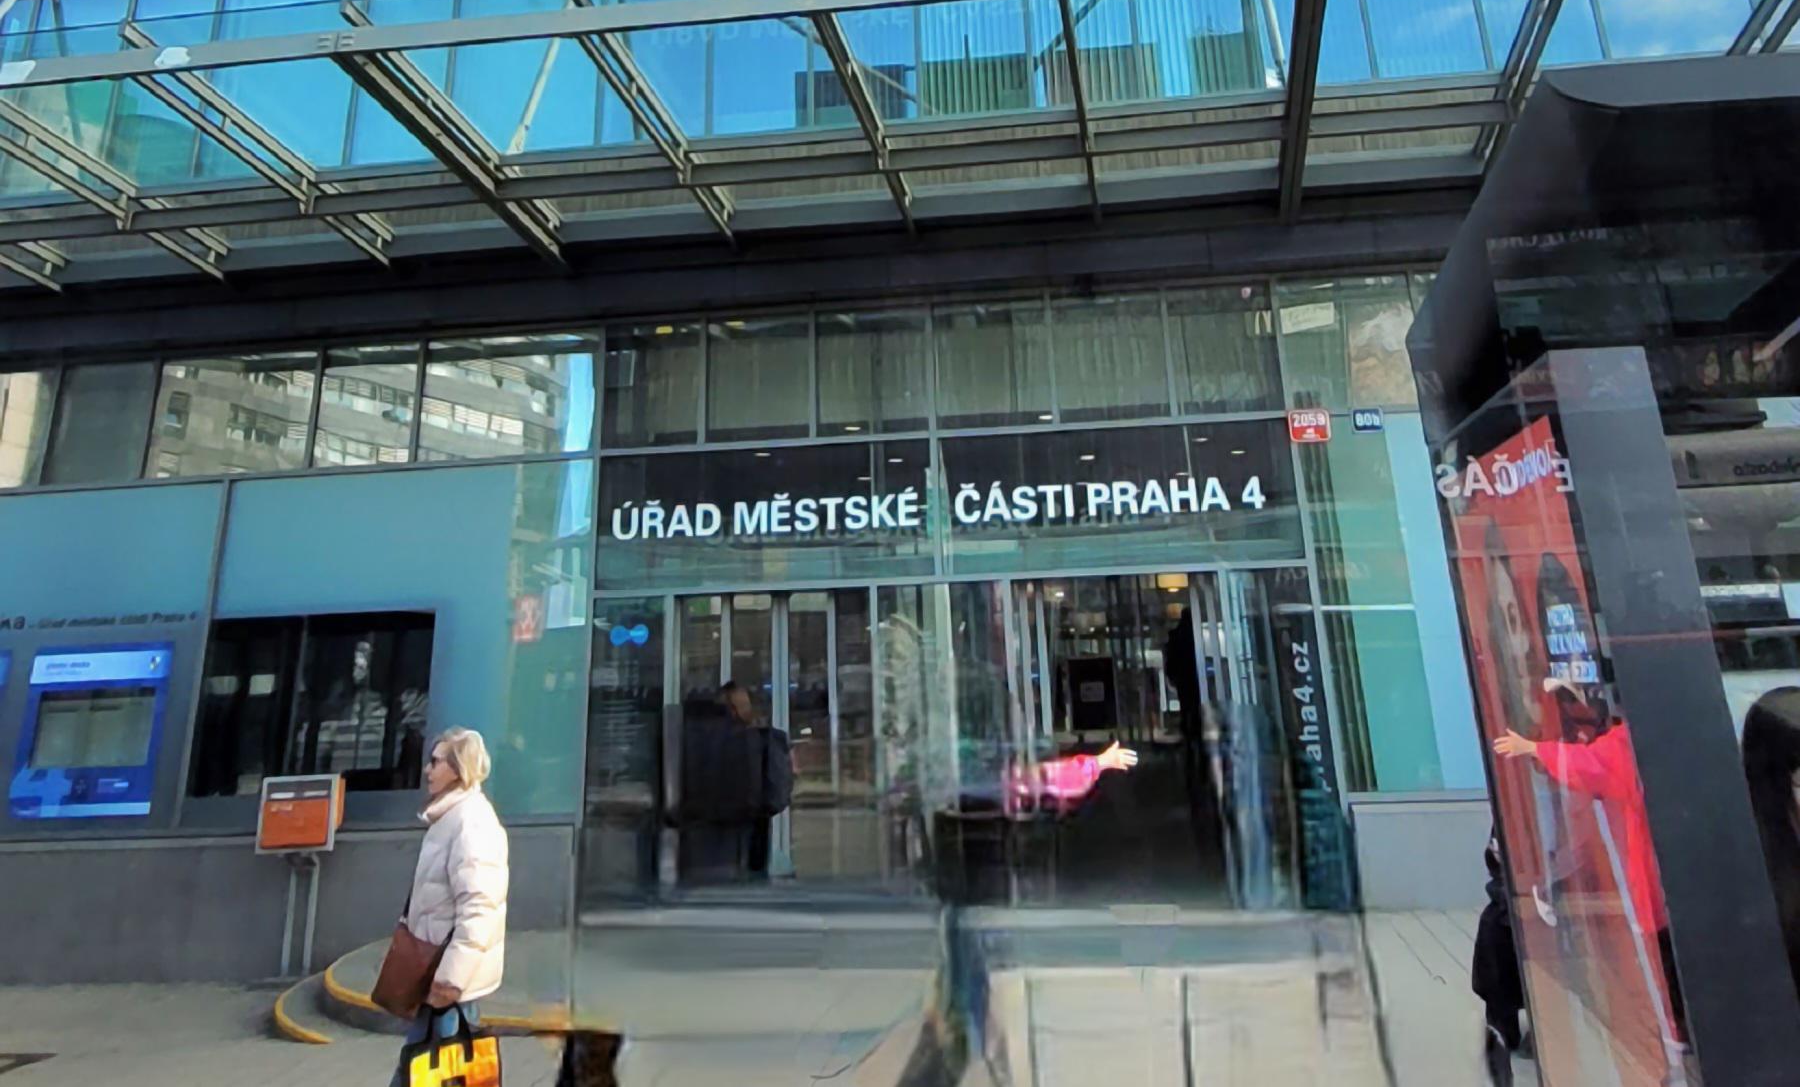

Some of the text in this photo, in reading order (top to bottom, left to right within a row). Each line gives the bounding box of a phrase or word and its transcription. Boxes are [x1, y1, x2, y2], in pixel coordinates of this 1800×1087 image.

[612, 496, 721, 540] ÚŘAD
[734, 486, 920, 536] MĚSTSKÉ
[954, 481, 1075, 523] ČÁSTI
[1087, 476, 1230, 516] PRAHA
[1242, 477, 1265, 510] 4
